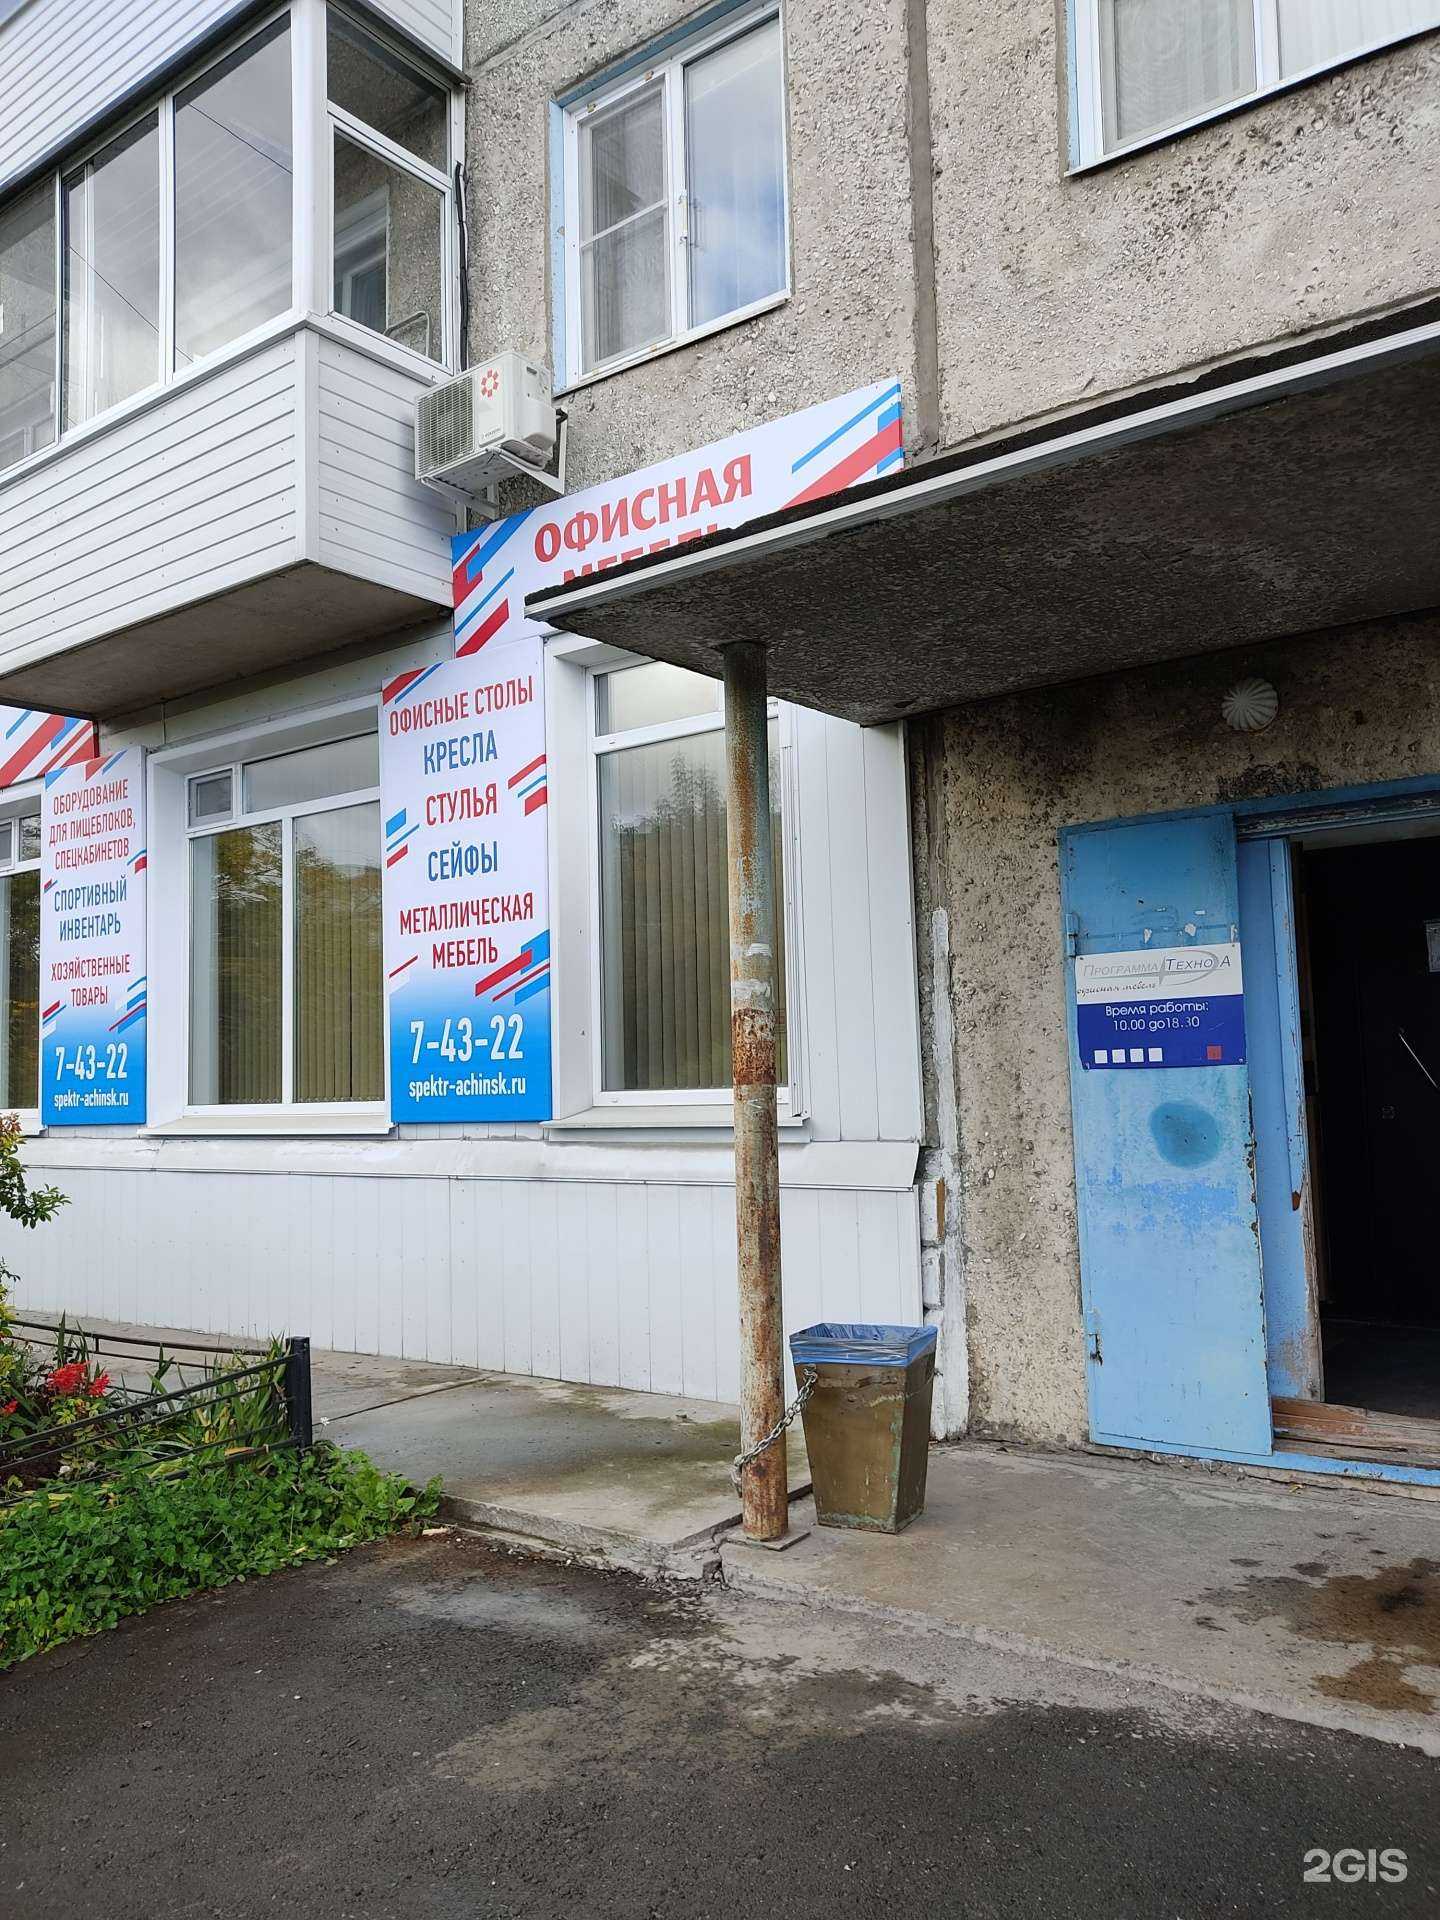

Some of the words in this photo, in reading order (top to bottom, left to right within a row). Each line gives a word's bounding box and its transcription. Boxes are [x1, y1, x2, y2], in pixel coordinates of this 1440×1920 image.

[534, 454, 752, 563] ОФИСНАЯ
[389, 691, 469, 735] ОФИСНЫЕ
[475, 675, 533, 714] СТОЛЫ
[423, 729, 498, 775] КРЕСЛА
[53, 778, 129, 815] ОБОРУДОВАНИЕ
[425, 782, 498, 827] СТУЛЬЯ
[49, 823, 68, 847] ДЛЯ
[69, 808, 136, 840] ПИЩЕБЛОКОВ,
[54, 837, 130, 870] СПЕЦКАБИНЕТОВ
[427, 840, 499, 882] СЕЙФЫ
[53, 875, 128, 913] СПОРТИВНЫЙ
[59, 913, 122, 941] ИНВЕНТАРЬ
[399, 892, 534, 936] МЕТАЛЛИЧЕСКАЯ
[50, 953, 131, 982] ХОЗЯЙСТВЕННЫЕ
[432, 937, 498, 970] МЕБЕЛЬ
[70, 986, 109, 1008] ТОВАРЫ
[409, 1013, 524, 1064] 7-43-22
[1113, 1019, 1146, 1032] 10.00
[55, 1042, 128, 1081] 7-43-22
[53, 1088, 129, 1110] spektr-achinsk.ru
[408, 1072, 526, 1100] spektr-achinsk.ru
